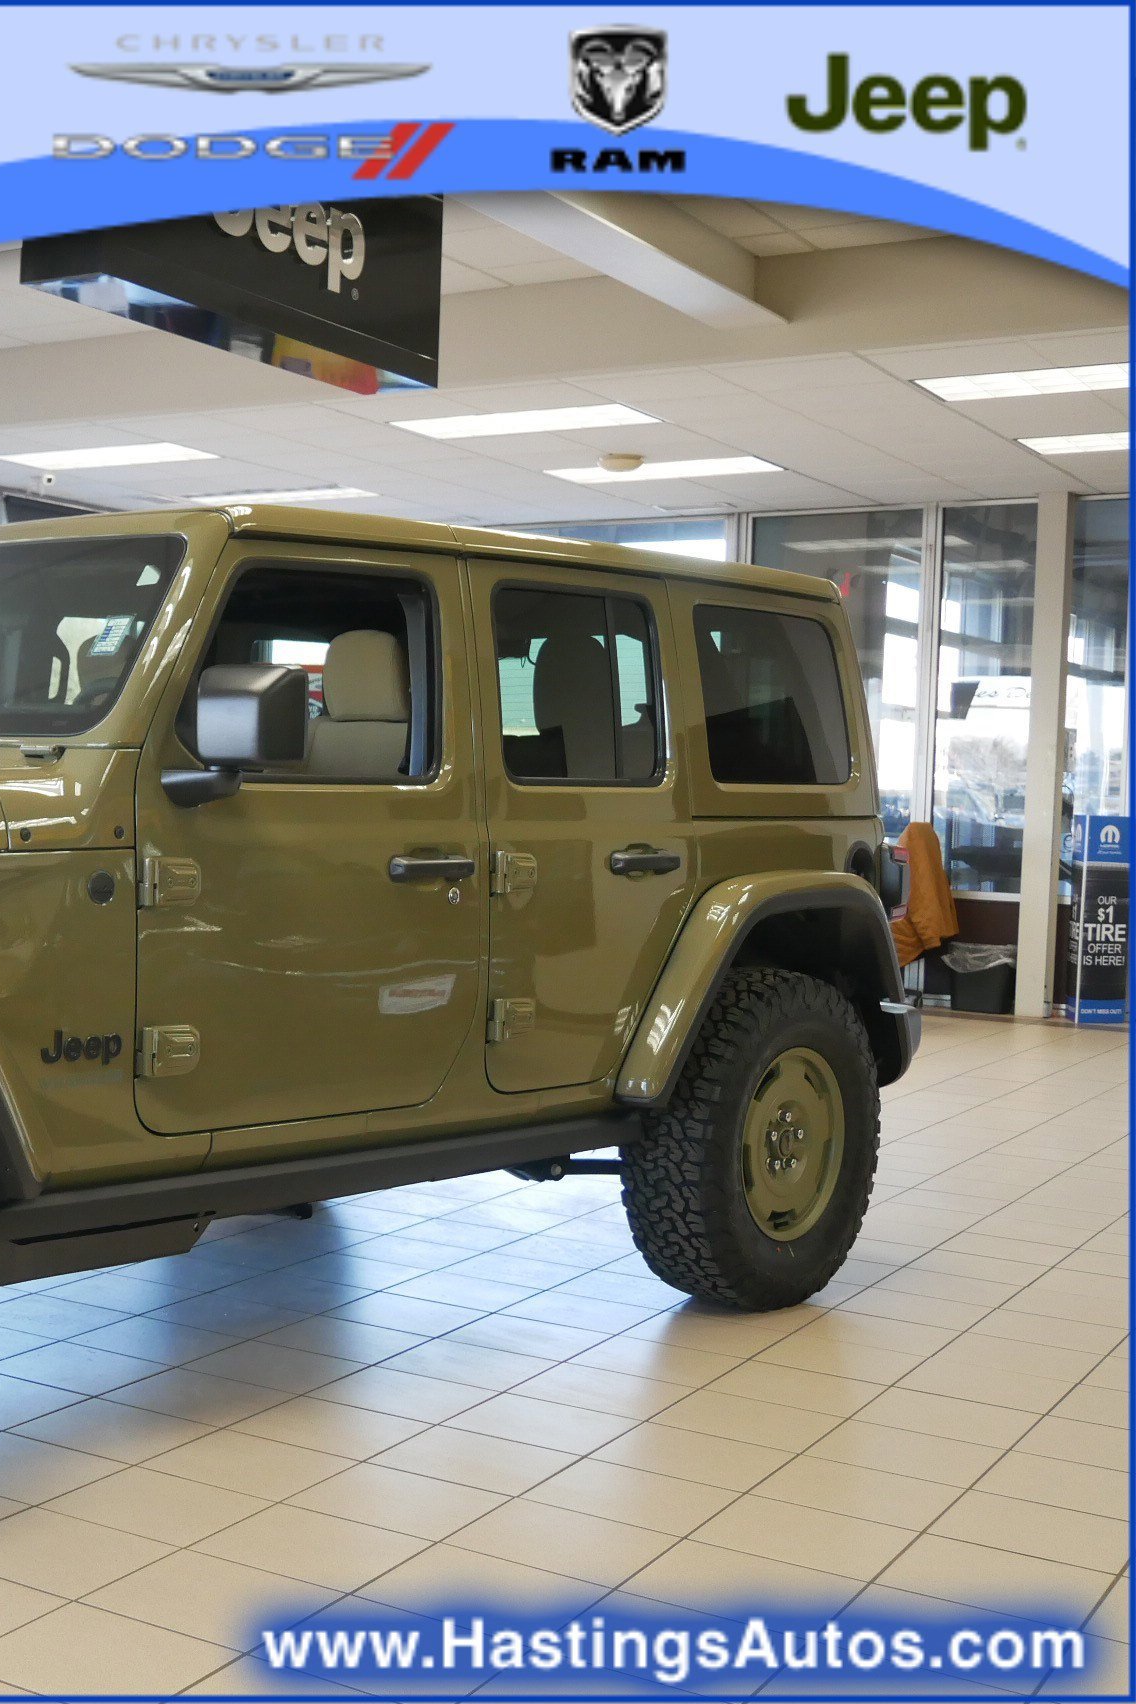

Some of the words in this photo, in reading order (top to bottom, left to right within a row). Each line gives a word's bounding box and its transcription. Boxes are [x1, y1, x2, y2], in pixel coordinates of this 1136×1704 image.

[1098, 895, 1117, 906] OUR
[1098, 905, 1114, 923] $1
[1084, 923, 1127, 943] TIRE
[1088, 943, 1122, 954] OFFER
[1083, 955, 1094, 966] IS
[1095, 955, 1126, 966] HERE!
[41, 1029, 123, 1067] Jeep
